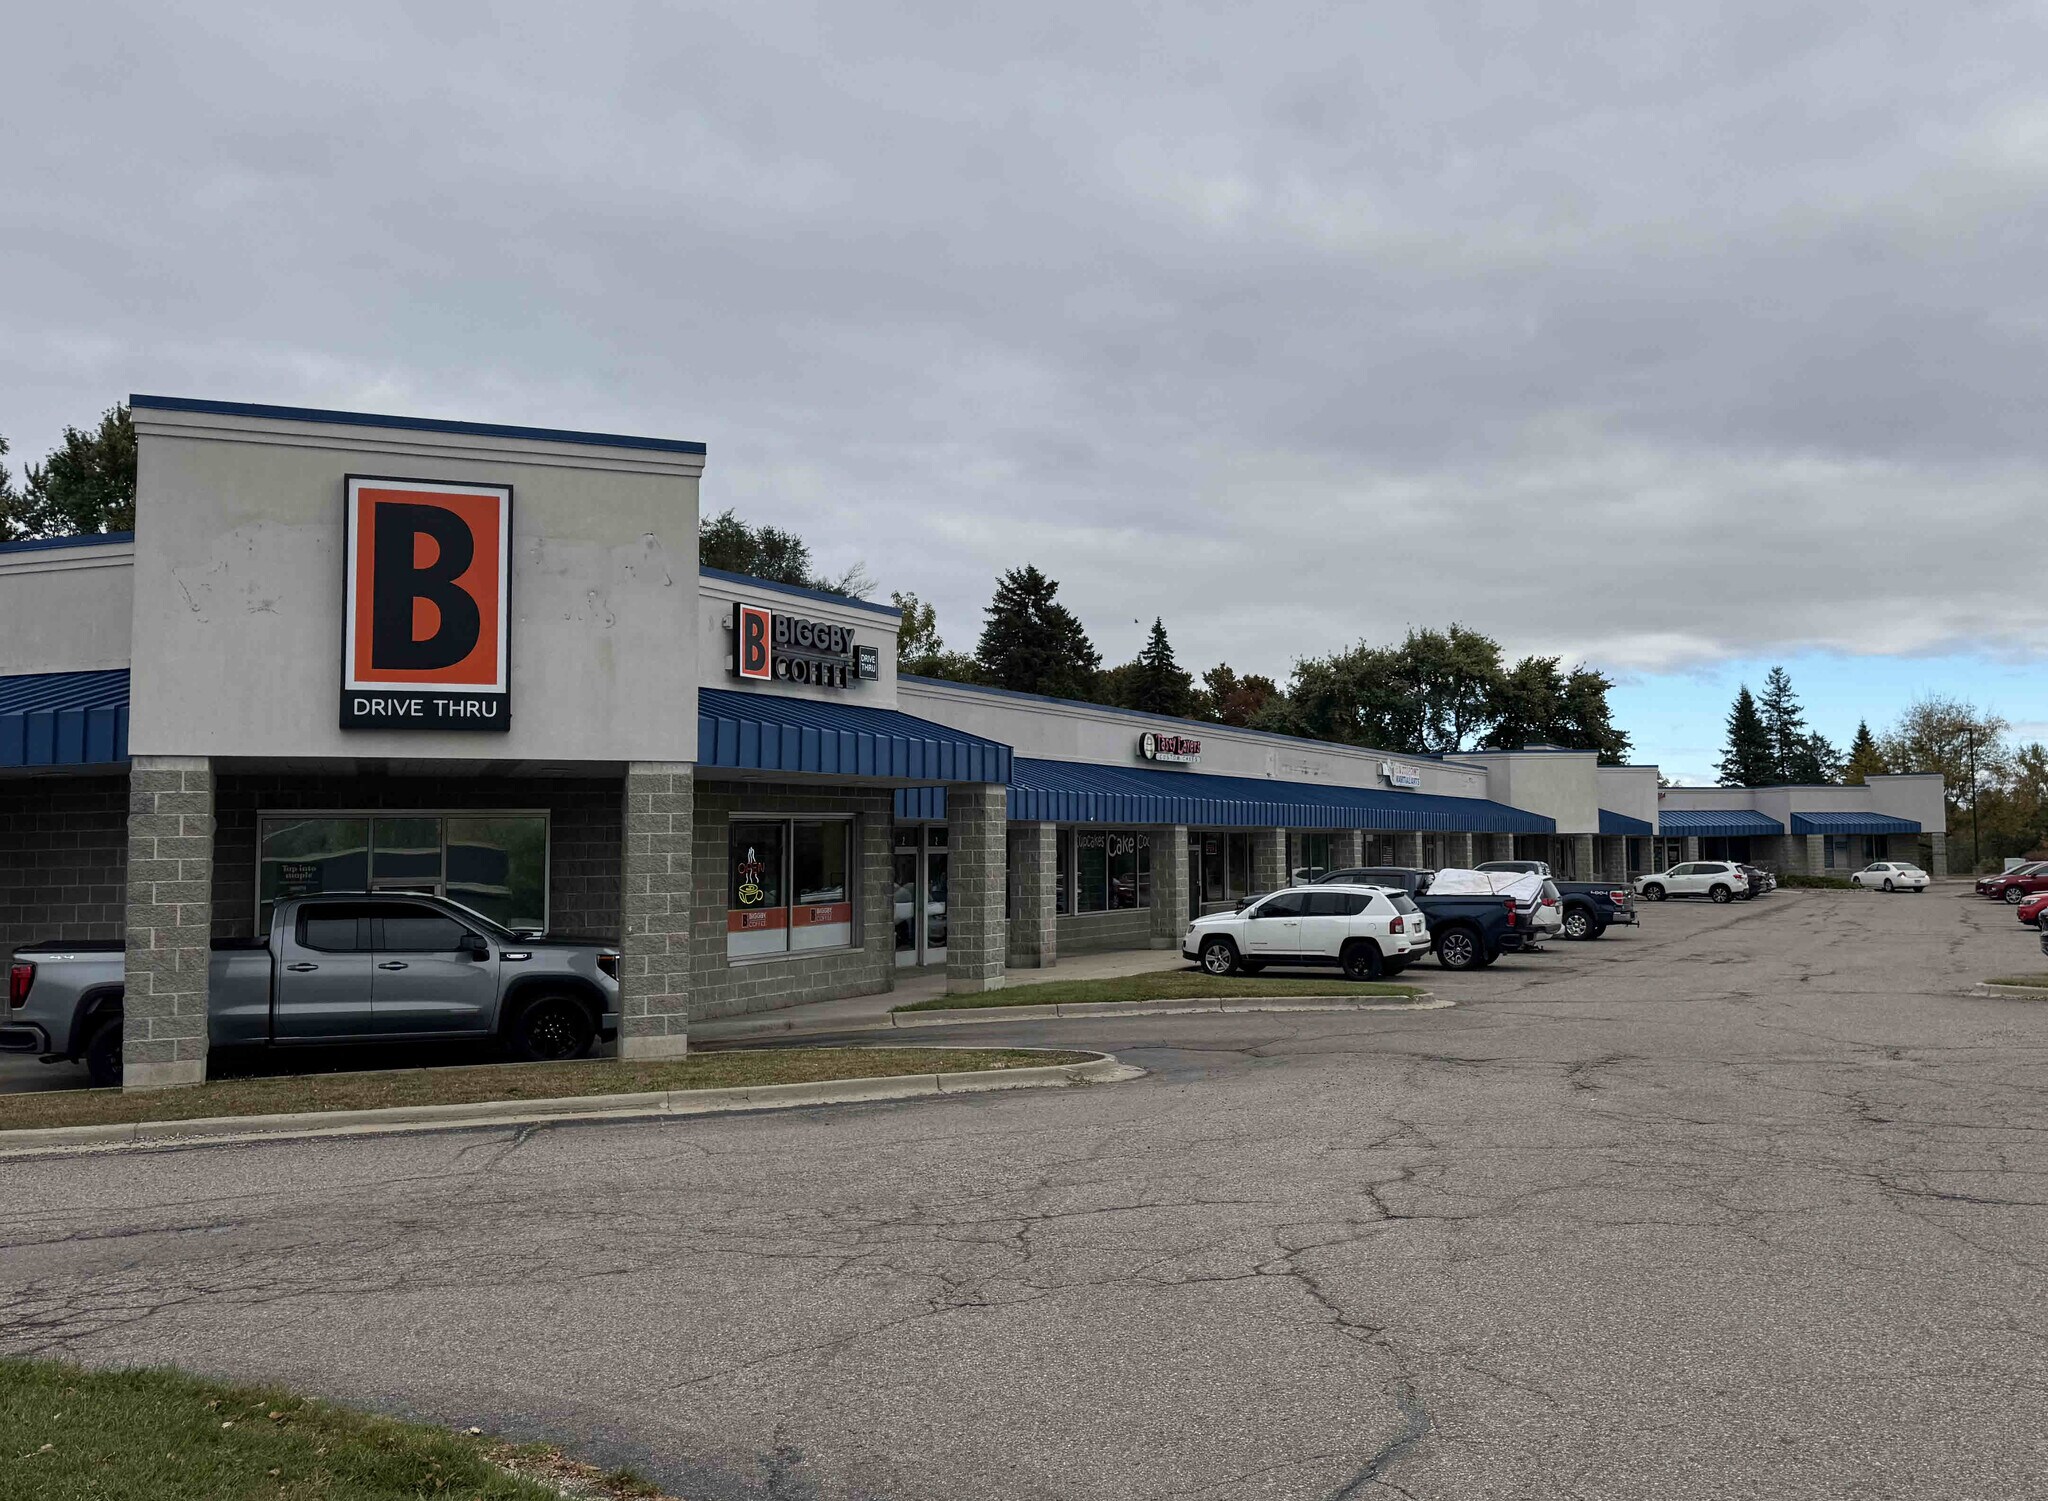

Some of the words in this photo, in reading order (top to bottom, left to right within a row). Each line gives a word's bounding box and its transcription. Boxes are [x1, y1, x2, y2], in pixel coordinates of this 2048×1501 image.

[371, 501, 481, 671] B
[744, 612, 766, 672] B
[775, 614, 855, 653] BIGGBY
[860, 654, 876, 663] DRIVE
[861, 662, 876, 672] THRU
[775, 656, 856, 690] COFFEE
[353, 698, 424, 716] DRIVE
[432, 700, 497, 718] THRU
[1155, 732, 1177, 752] Tasty
[1177, 736, 1201, 755] Layers
[1107, 833, 1135, 857] Cake
[738, 862, 765, 875] OPEN
